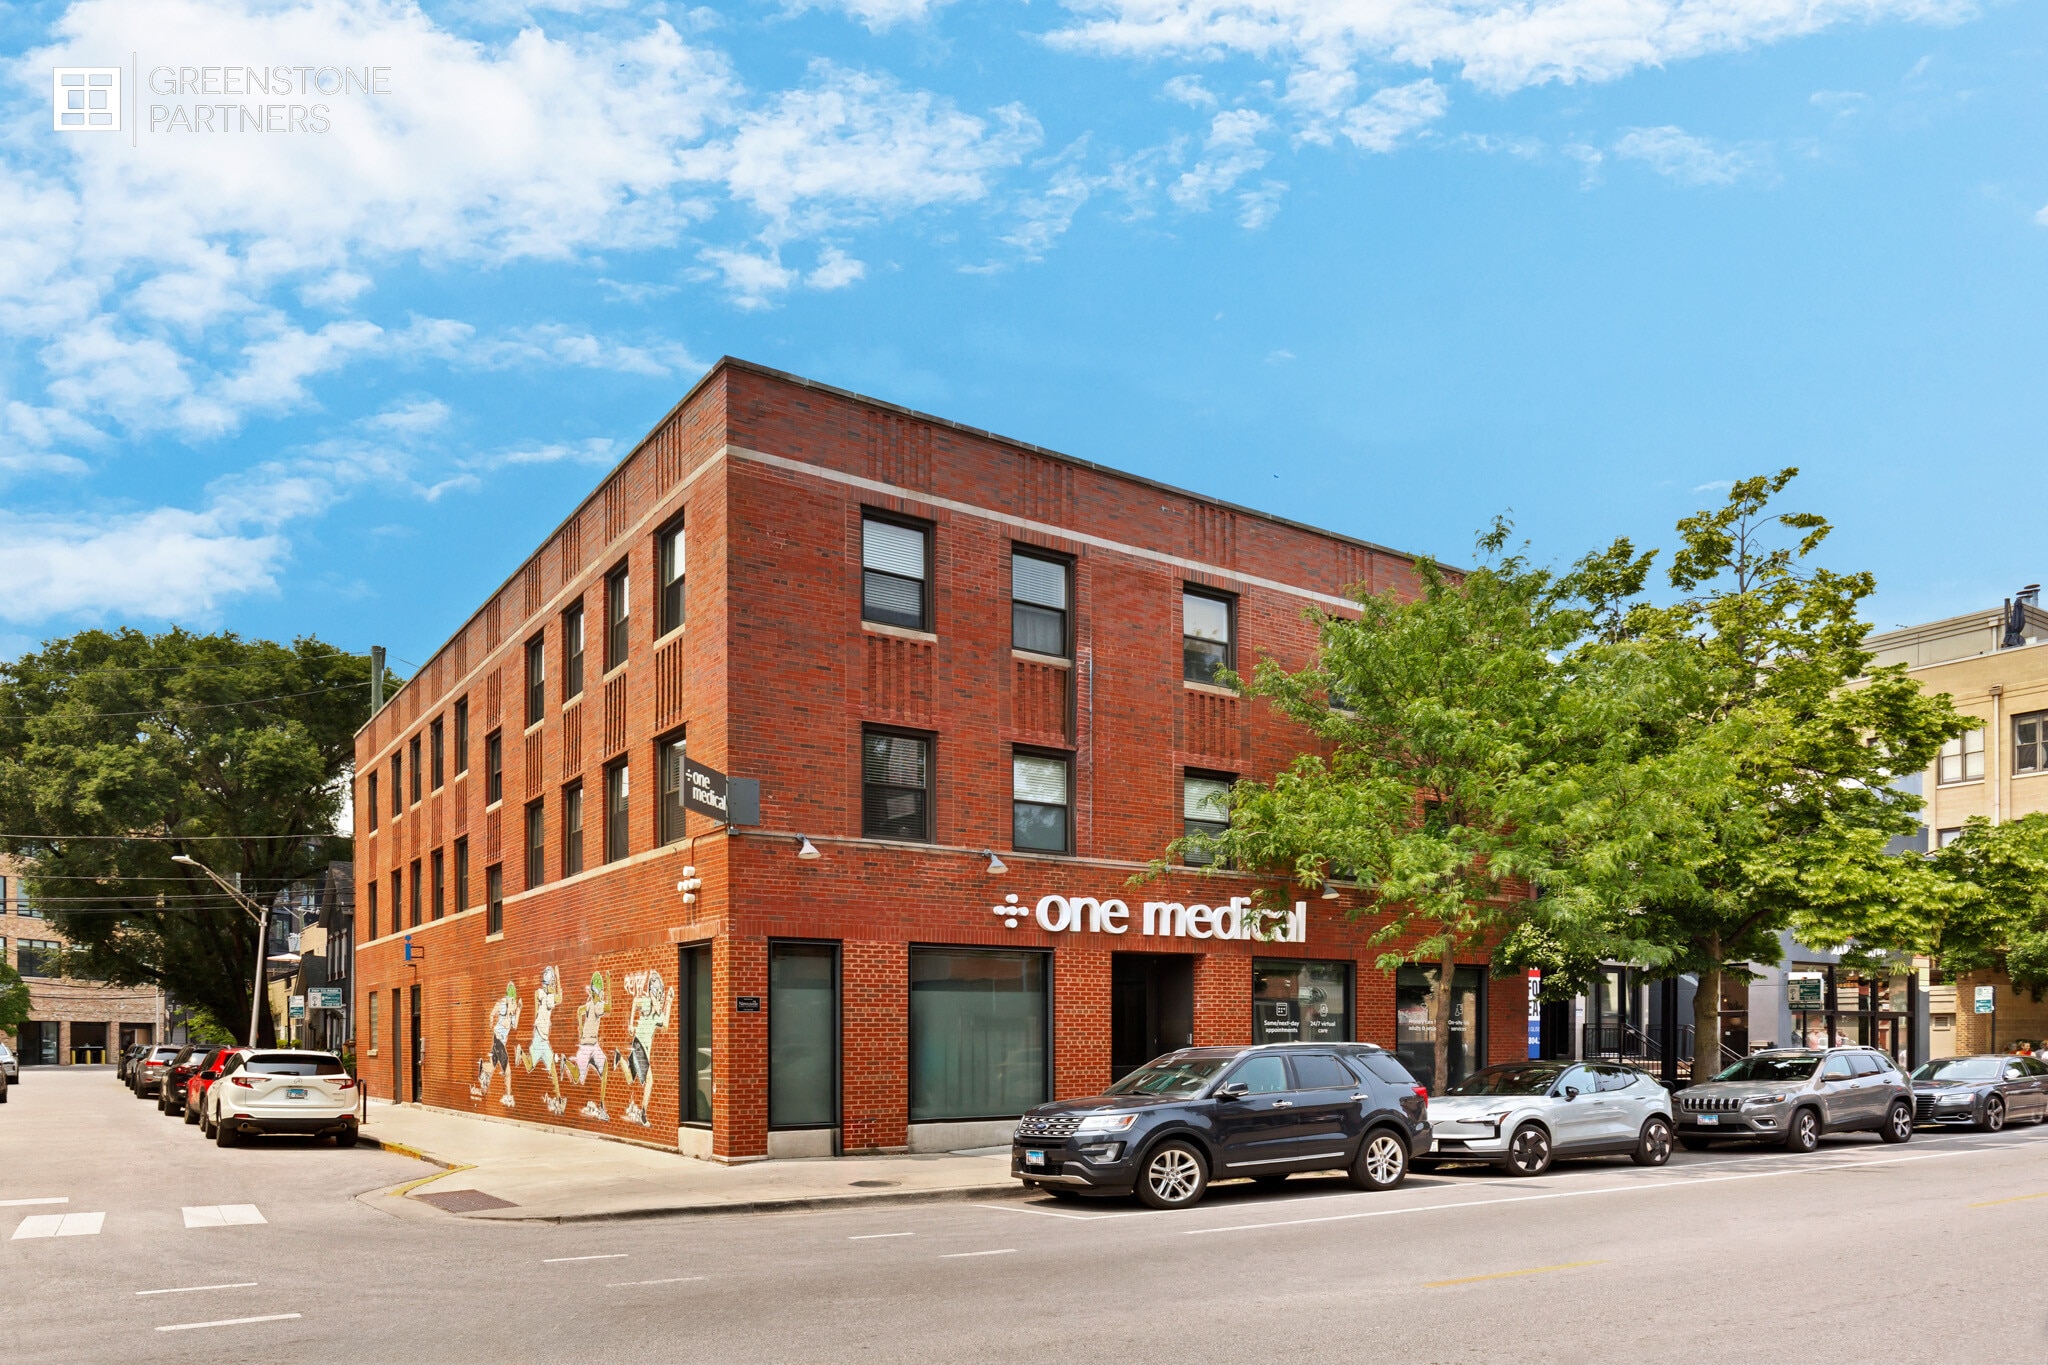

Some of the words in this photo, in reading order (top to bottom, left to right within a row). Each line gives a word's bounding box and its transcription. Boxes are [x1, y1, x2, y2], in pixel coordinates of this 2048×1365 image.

[692, 771, 711, 790] one
[692, 786, 726, 811] medical
[1036, 894, 1130, 934] one
[1143, 896, 1306, 943] medical
